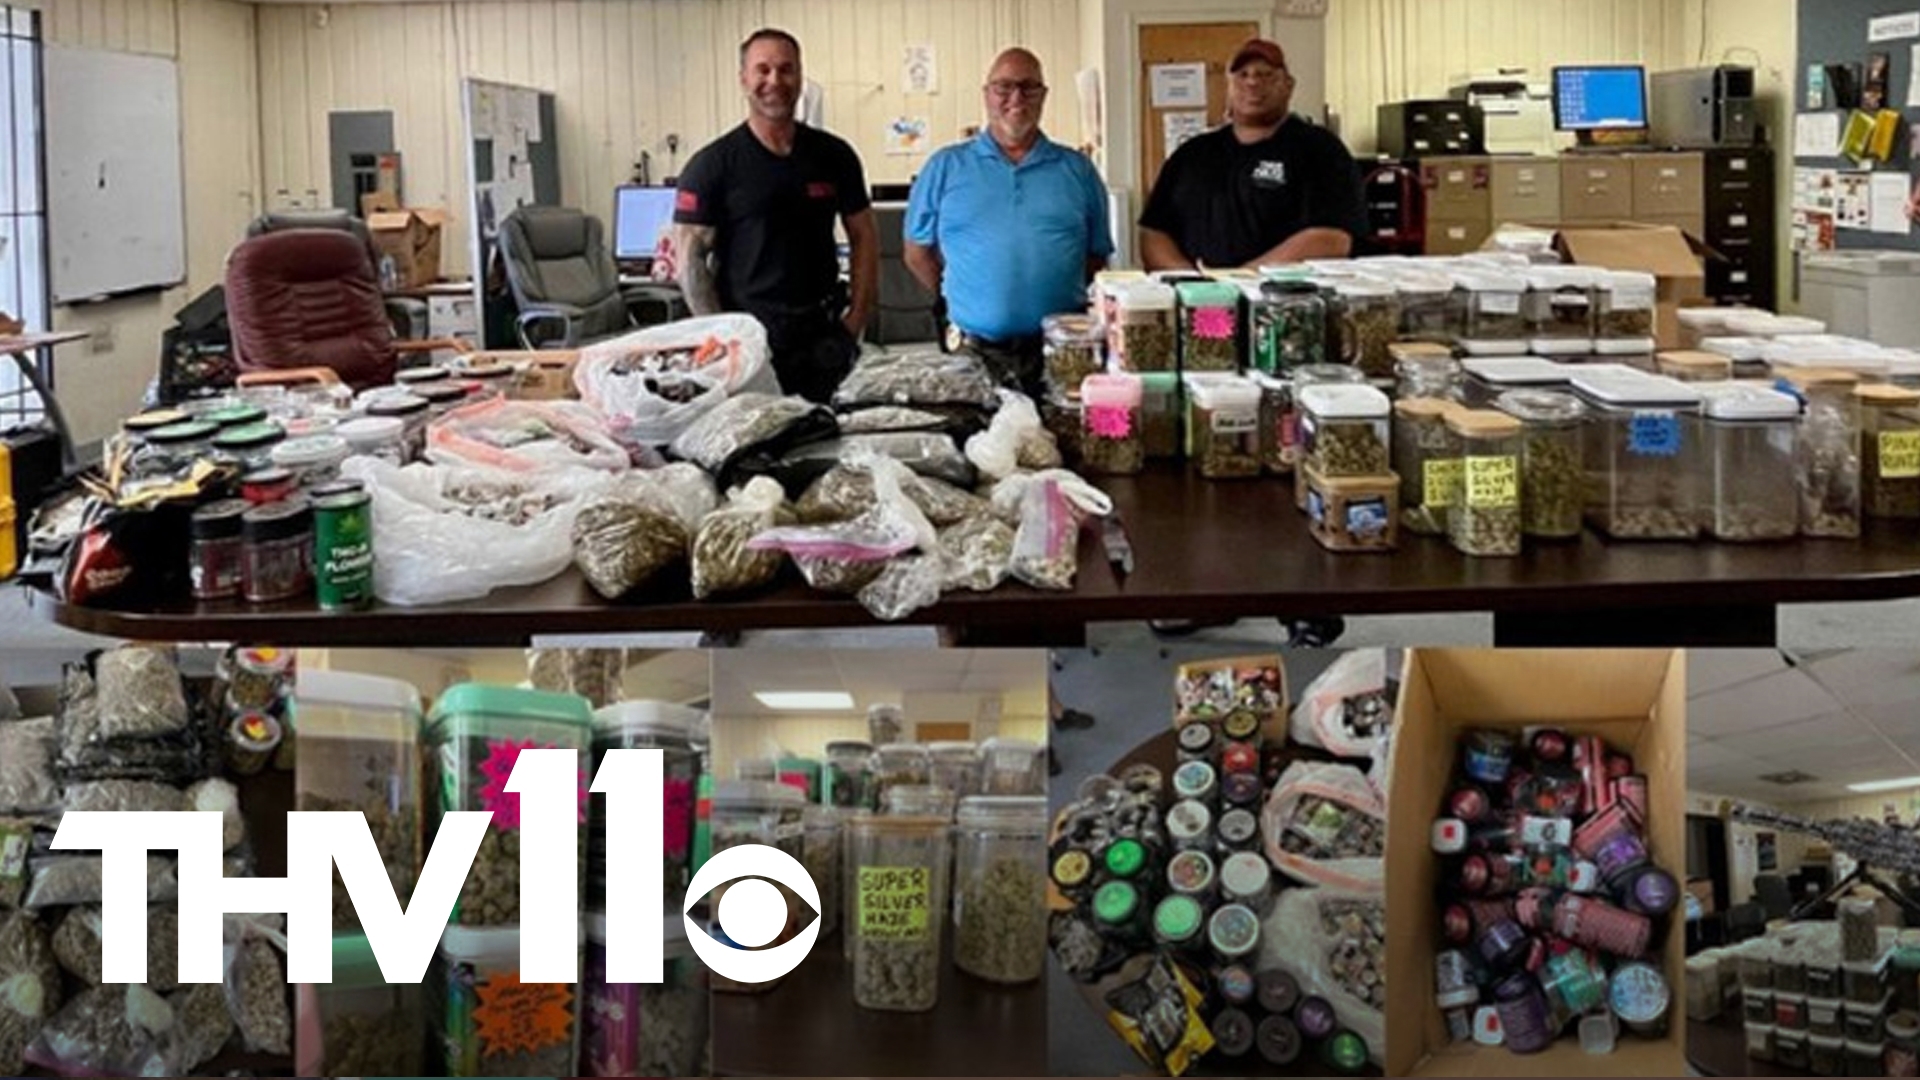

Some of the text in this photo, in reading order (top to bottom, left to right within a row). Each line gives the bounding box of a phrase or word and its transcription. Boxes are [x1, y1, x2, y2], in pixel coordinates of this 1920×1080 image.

[861, 868, 926, 892] SUPER
[864, 891, 927, 911] SILVER
[866, 911, 910, 927] HAZE
